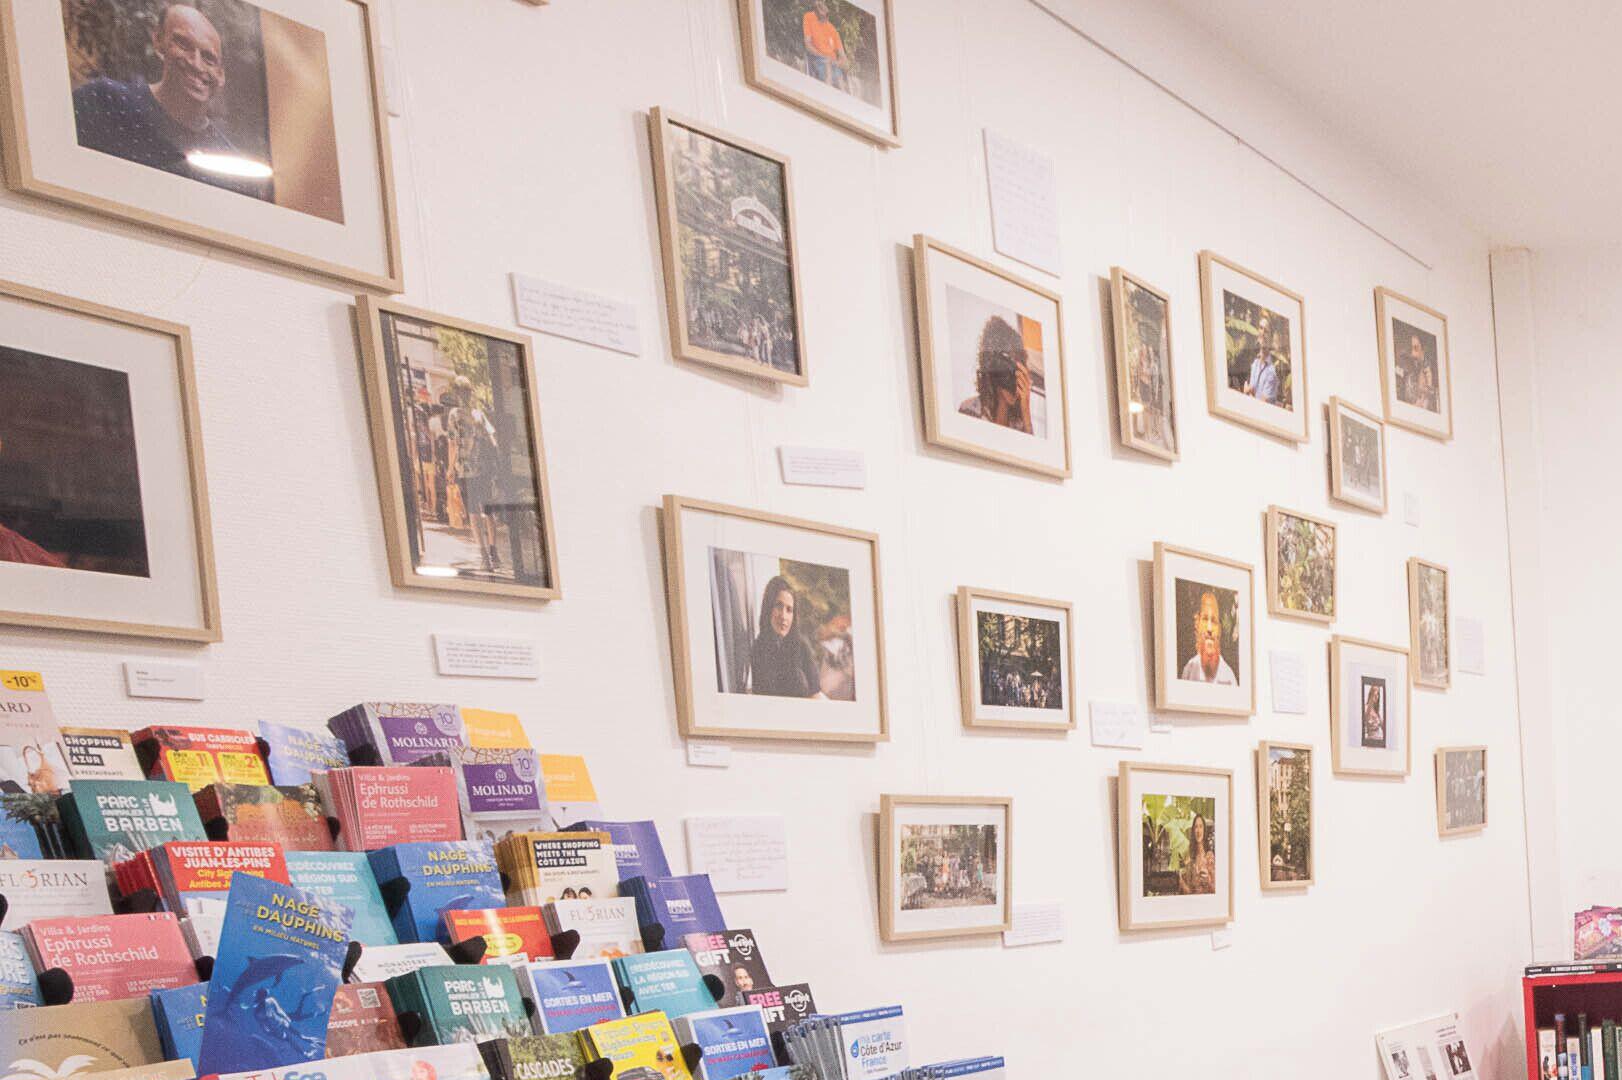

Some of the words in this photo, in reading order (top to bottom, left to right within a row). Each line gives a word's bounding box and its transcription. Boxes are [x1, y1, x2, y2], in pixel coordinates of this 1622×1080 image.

[391, 736, 458, 749] MOLINARD
[360, 783, 409, 798] Ephrussi
[472, 784, 533, 797] MOLINARD
[96, 795, 139, 809] PARC
[362, 797, 378, 809] de
[380, 796, 439, 809] Rothschild
[104, 817, 184, 832] BARBEN
[171, 847, 210, 858] VISITE
[213, 846, 276, 858] D'ANTIBES
[535, 842, 561, 850] WHERE
[562, 840, 600, 850] SHOPPING
[427, 849, 467, 862] NAGE
[561, 850, 576, 858] THE
[183, 857, 271, 869] JUAN-LES-PINS
[422, 863, 494, 877] DAUPHINS
[272, 893, 321, 918] NAGE
[256, 905, 346, 943] DAUPHINS
[44, 934, 113, 955] Ephrussi
[51, 955, 73, 969] de
[76, 947, 160, 966] Rothschild
[696, 949, 731, 966] GIFT
[444, 980, 477, 993] PARC
[578, 994, 592, 1004] EN
[592, 991, 614, 1002] MER
[748, 991, 784, 1008] FREE
[450, 999, 510, 1016] BARBEN
[763, 1006, 785, 1024] IFT
[748, 1037, 766, 1049] MER
[860, 1044, 878, 1057] Côte
[878, 1040, 904, 1054] d'Azur
[861, 1055, 888, 1068] France
[516, 1058, 576, 1080] CASCADES
